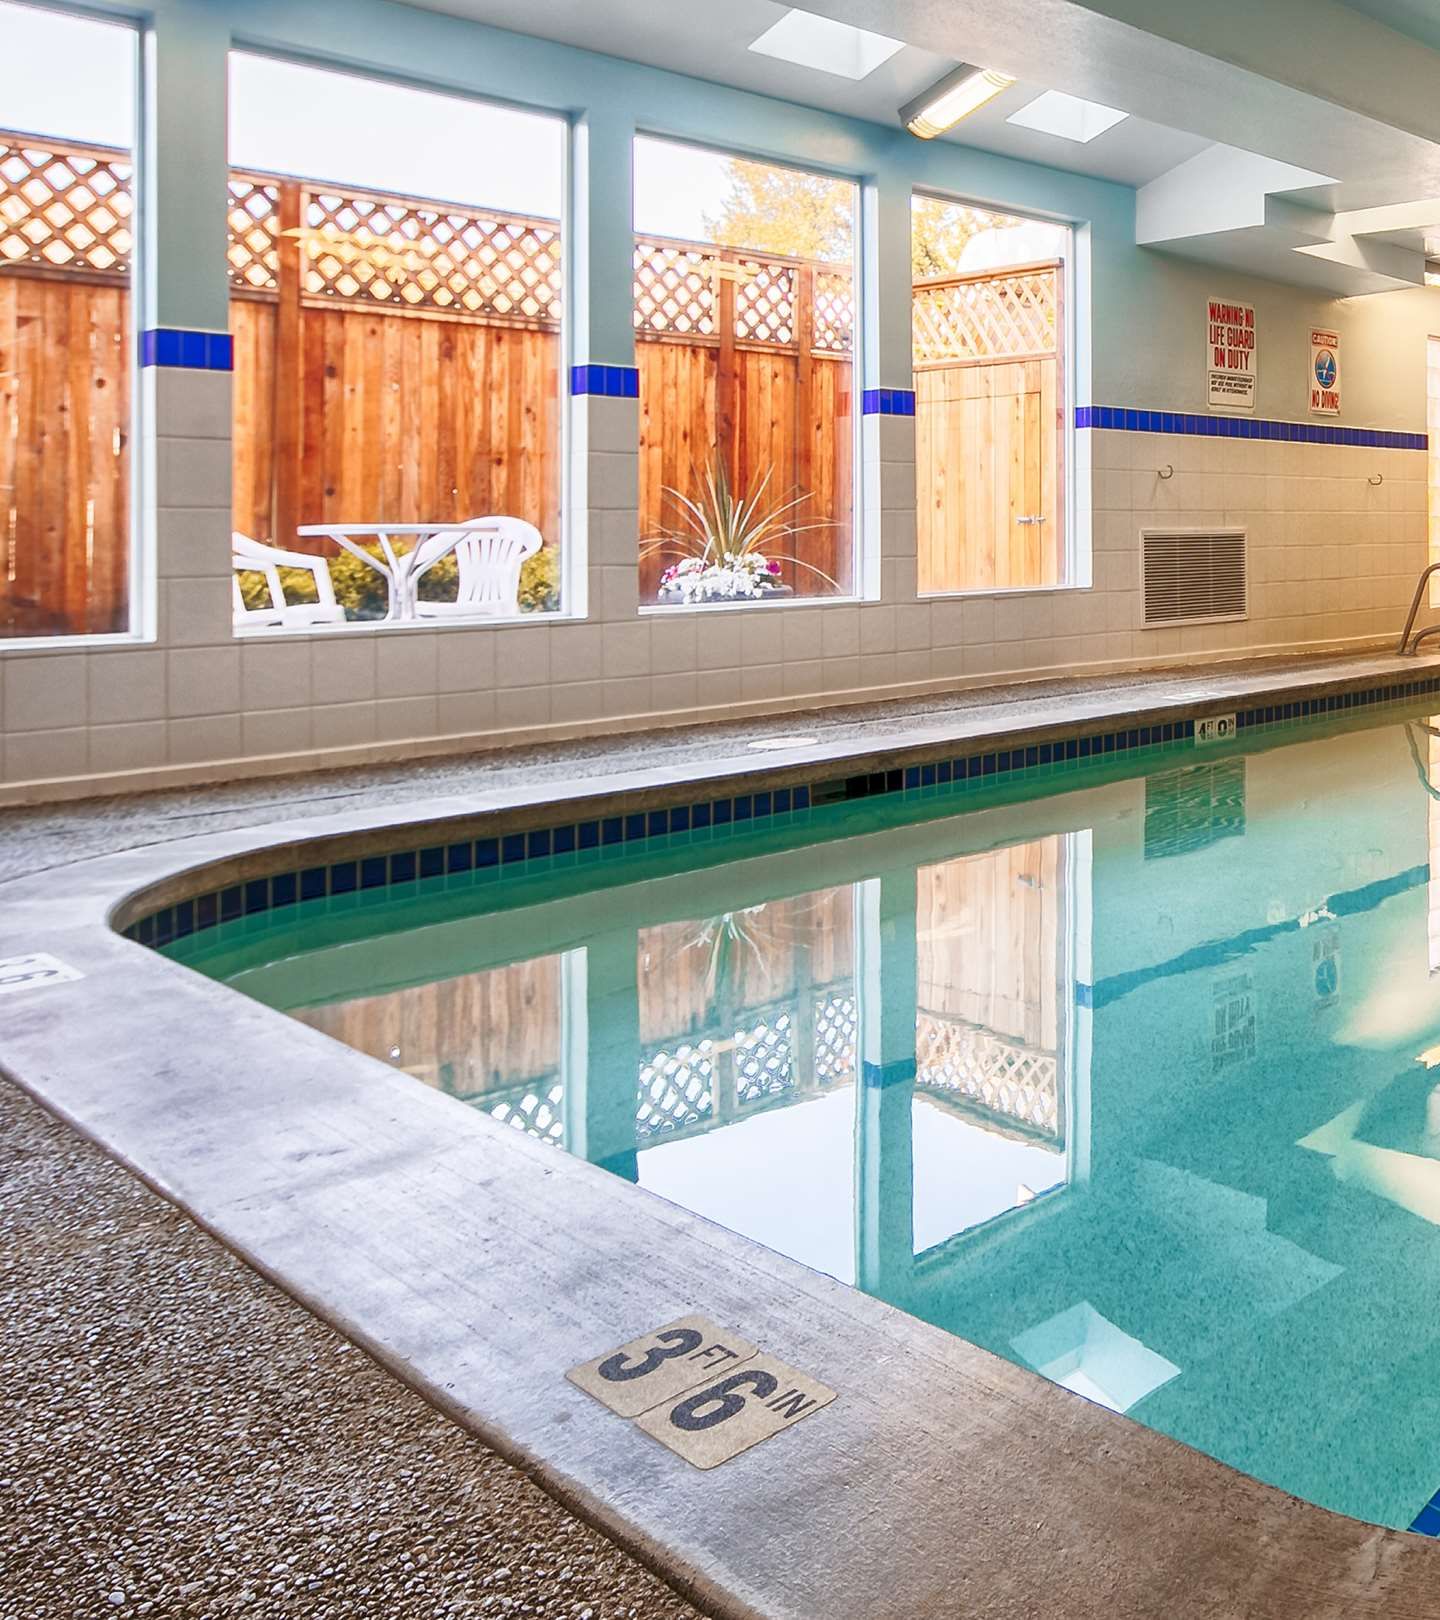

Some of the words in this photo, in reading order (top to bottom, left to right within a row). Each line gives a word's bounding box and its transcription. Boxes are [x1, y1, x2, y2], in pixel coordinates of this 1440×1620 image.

[1209, 302, 1244, 325] WARNING
[1245, 308, 1255, 329] NO
[1209, 324, 1225, 345] LIFE
[1227, 327, 1255, 350] GUARD
[1214, 347, 1226, 368] ON
[1228, 349, 1250, 370] DUTY
[1312, 389, 1320, 408] NO
[598, 1328, 703, 1382] 3
[688, 1343, 739, 1371] FT
[669, 1369, 778, 1431] 6
[765, 1388, 817, 1420] IN
